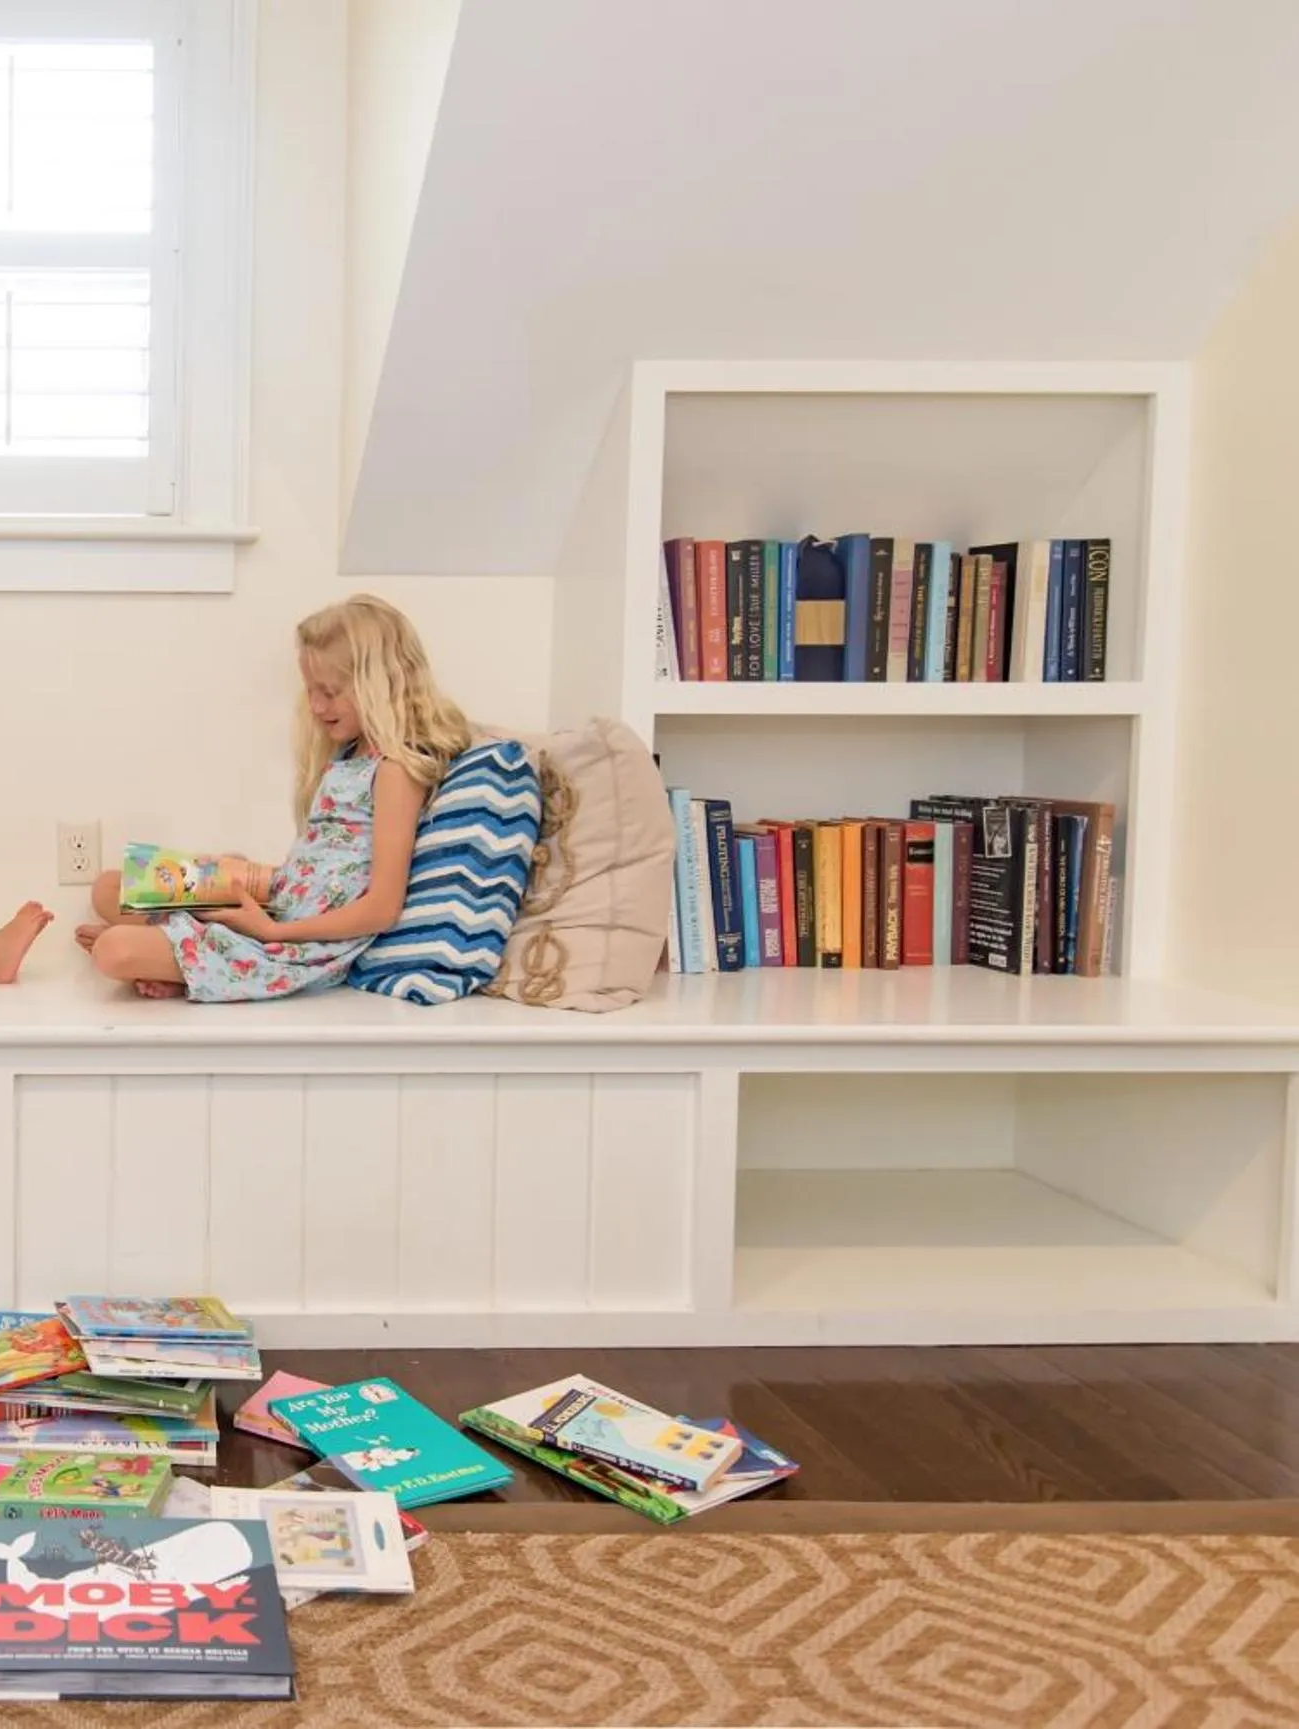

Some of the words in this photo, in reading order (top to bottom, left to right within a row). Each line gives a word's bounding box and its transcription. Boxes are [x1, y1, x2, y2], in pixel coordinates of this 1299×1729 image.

[1088, 545, 1109, 581] ICON
[749, 621, 761, 649] LOVE
[749, 655, 760, 677] FOR
[715, 825, 729, 878] PILOTING
[886, 908, 898, 960] PAYBACK
[288, 1399, 318, 1413] Are
[317, 1391, 352, 1405] You
[315, 1405, 348, 1418] My
[301, 1407, 380, 1435] Mother?
